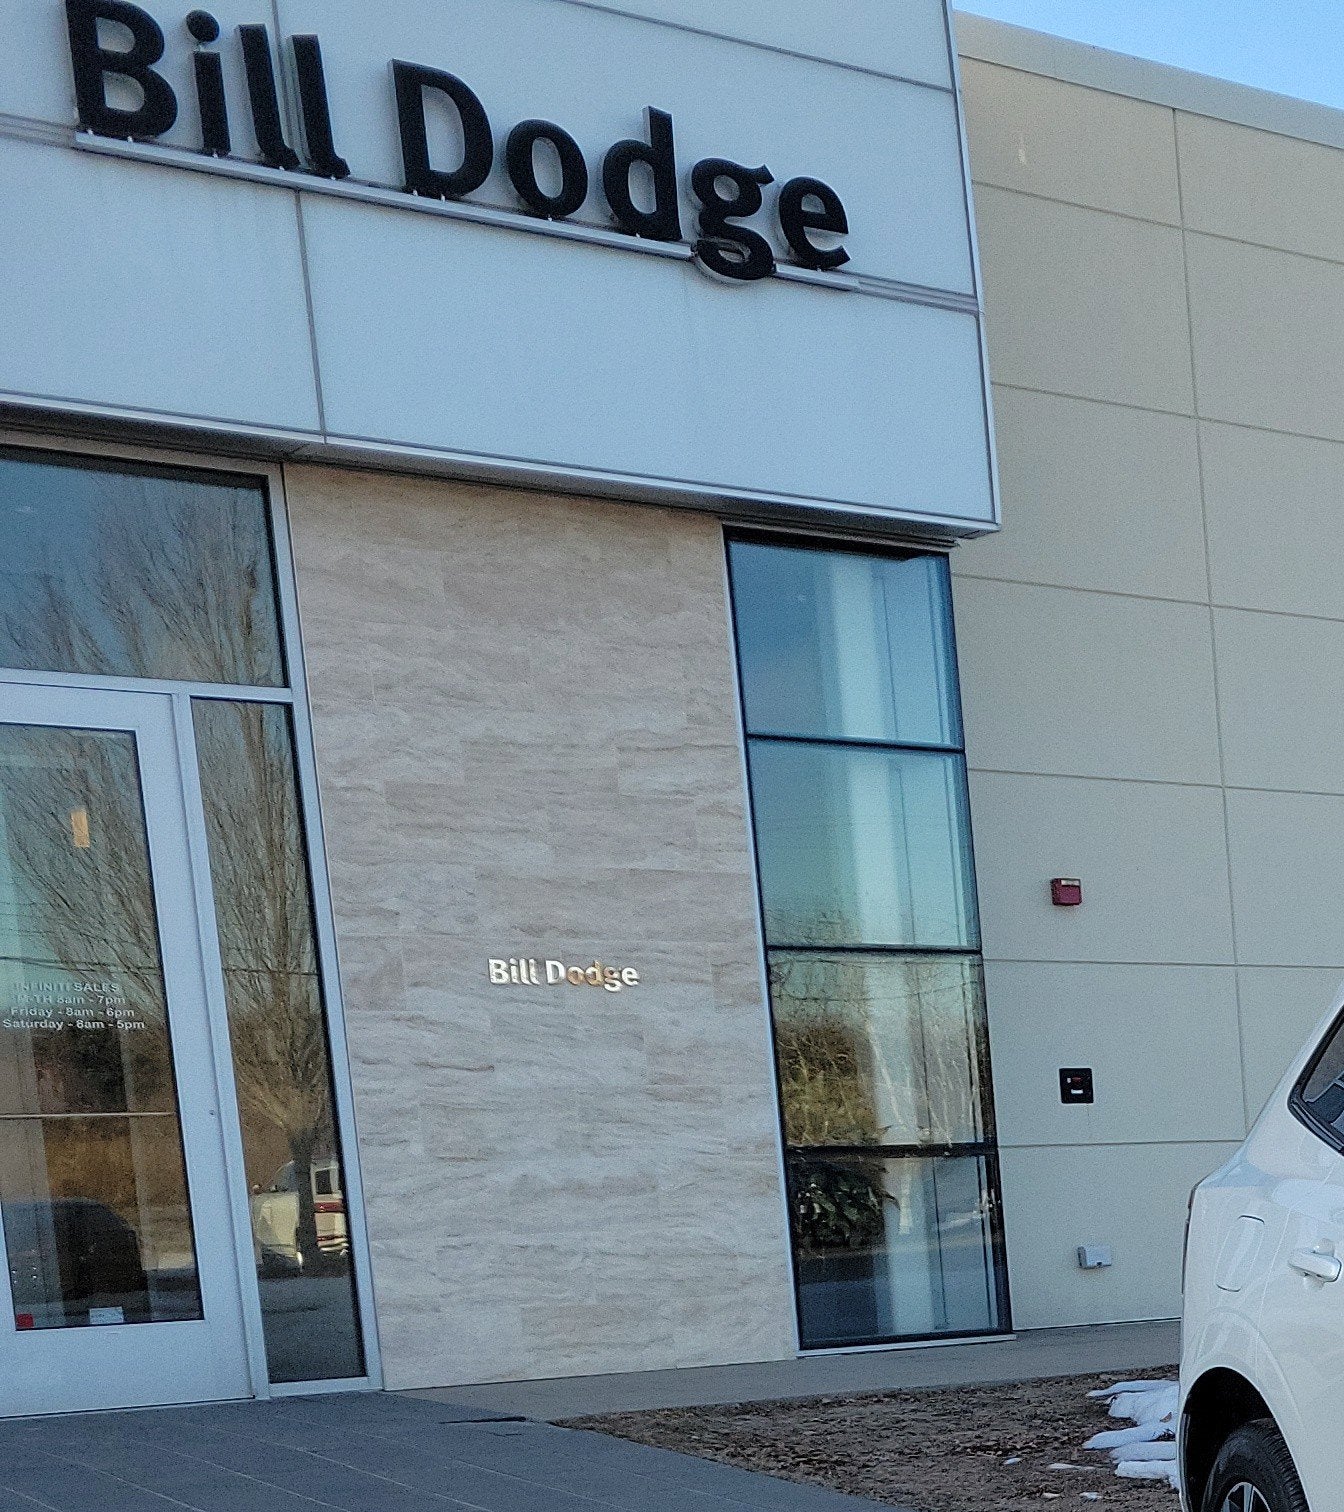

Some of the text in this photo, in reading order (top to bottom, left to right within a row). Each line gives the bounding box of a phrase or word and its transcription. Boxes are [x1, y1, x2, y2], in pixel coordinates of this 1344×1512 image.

[66, 0, 850, 283] Bill Dodge
[488, 958, 640, 993] Bill Dodge
[74, 981, 120, 992] SALES
[97, 995, 126, 1006] 7pm
[10, 1006, 54, 1019] Friday
[65, 1006, 94, 1017] 8am
[106, 1007, 135, 1019] 6pm
[2, 1018, 64, 1031] Saturday
[117, 1019, 145, 1031] 5pm
